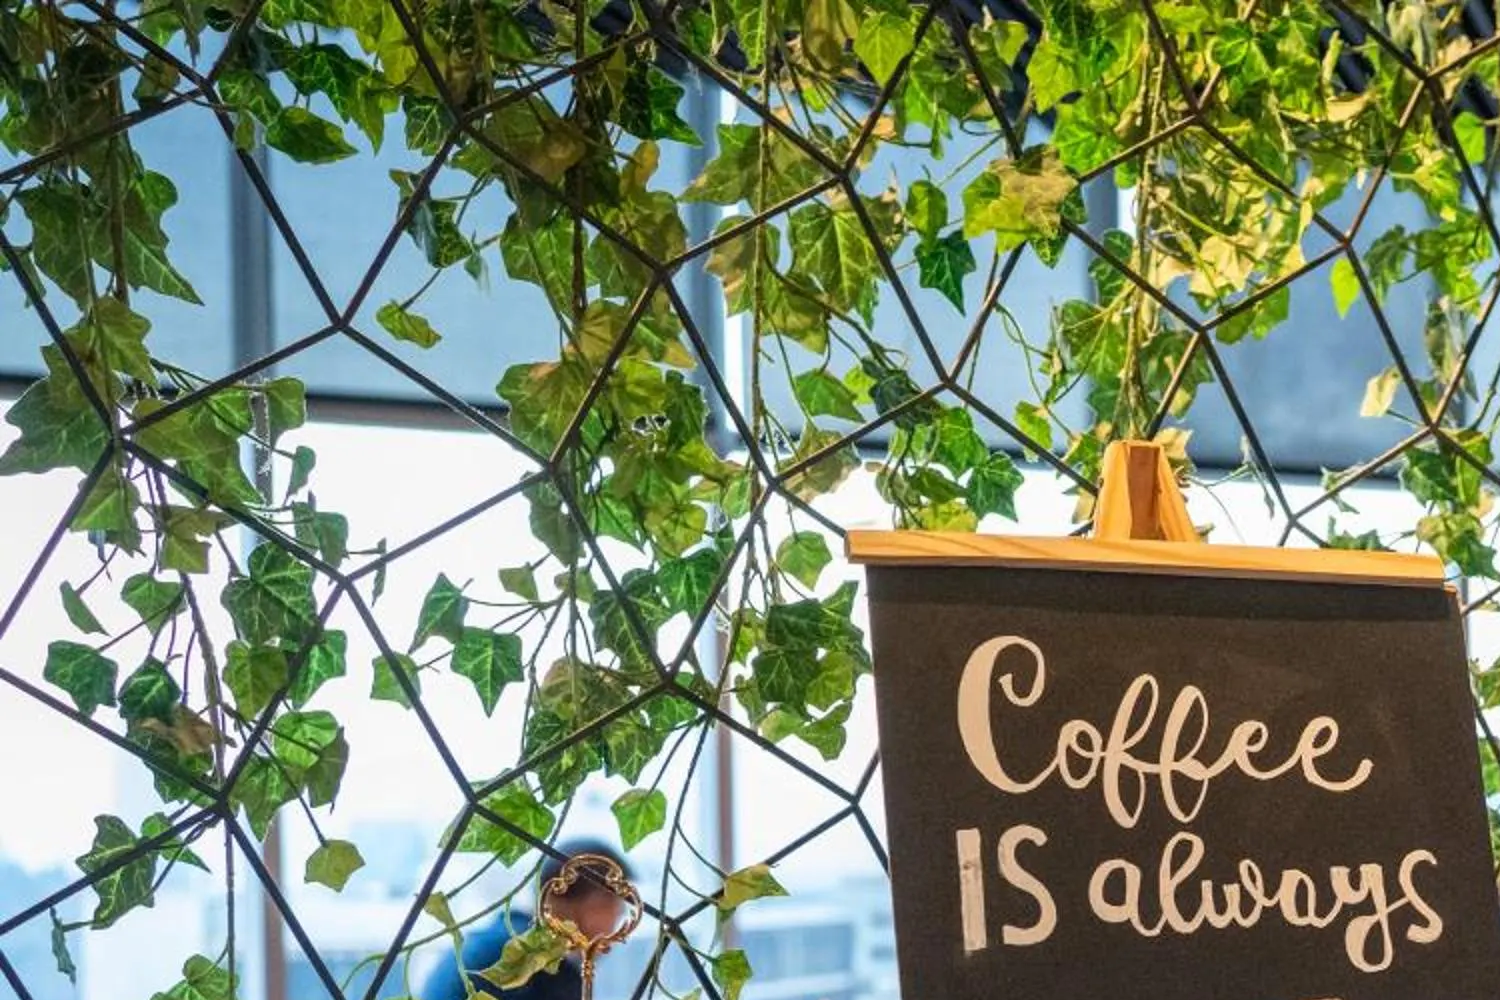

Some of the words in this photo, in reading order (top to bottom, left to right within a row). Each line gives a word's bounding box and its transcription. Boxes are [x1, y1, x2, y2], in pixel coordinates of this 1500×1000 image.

[957, 635, 1374, 828] Coffee
[956, 824, 1057, 956] IS
[1088, 831, 1444, 972] always
